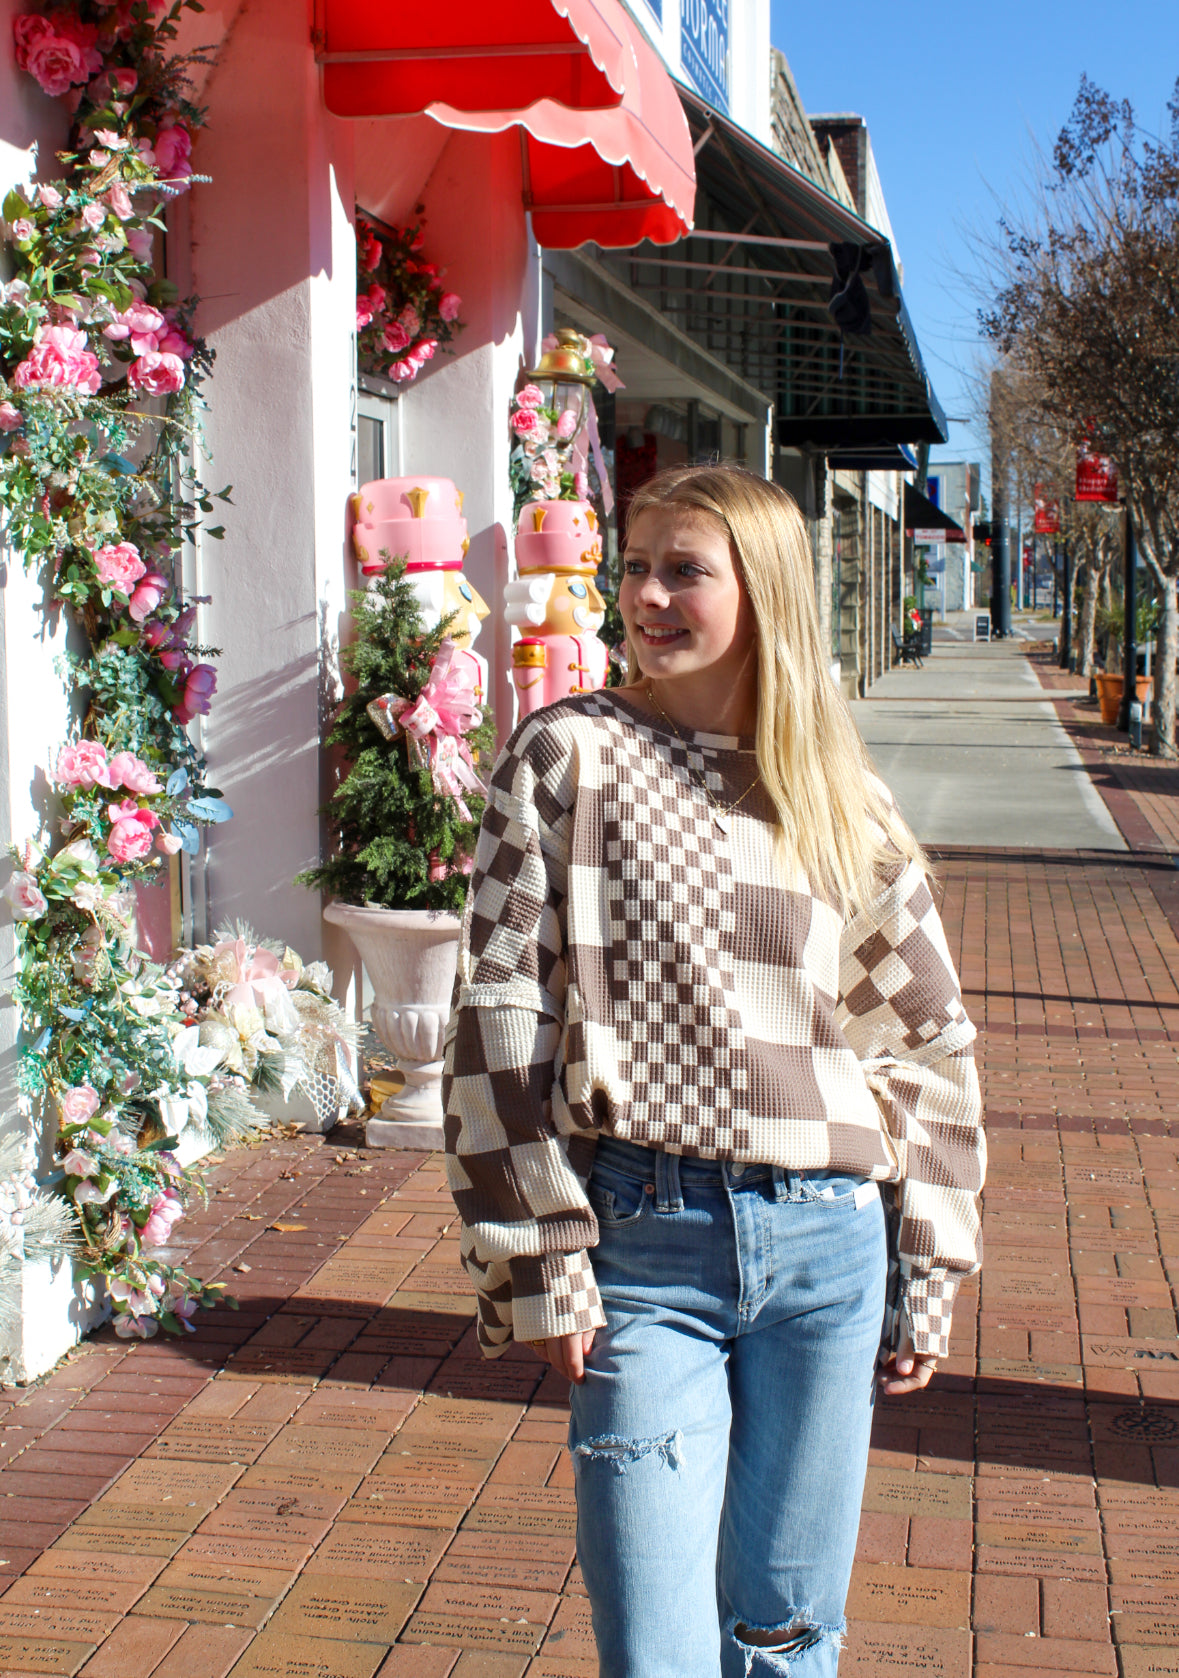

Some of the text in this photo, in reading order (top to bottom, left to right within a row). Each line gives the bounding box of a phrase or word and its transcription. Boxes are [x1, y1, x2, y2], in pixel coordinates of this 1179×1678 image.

[1004, 1536, 1055, 1544] Campbell
[1014, 1556, 1067, 1564] Campbell
[890, 1591, 937, 1601] Memory
[354, 1602, 388, 1610] Adam
[445, 1599, 479, 1608] Peggy
[410, 1628, 463, 1638] Meredith
[447, 1624, 494, 1633] Kathryn
[875, 1657, 927, 1668] Memory
